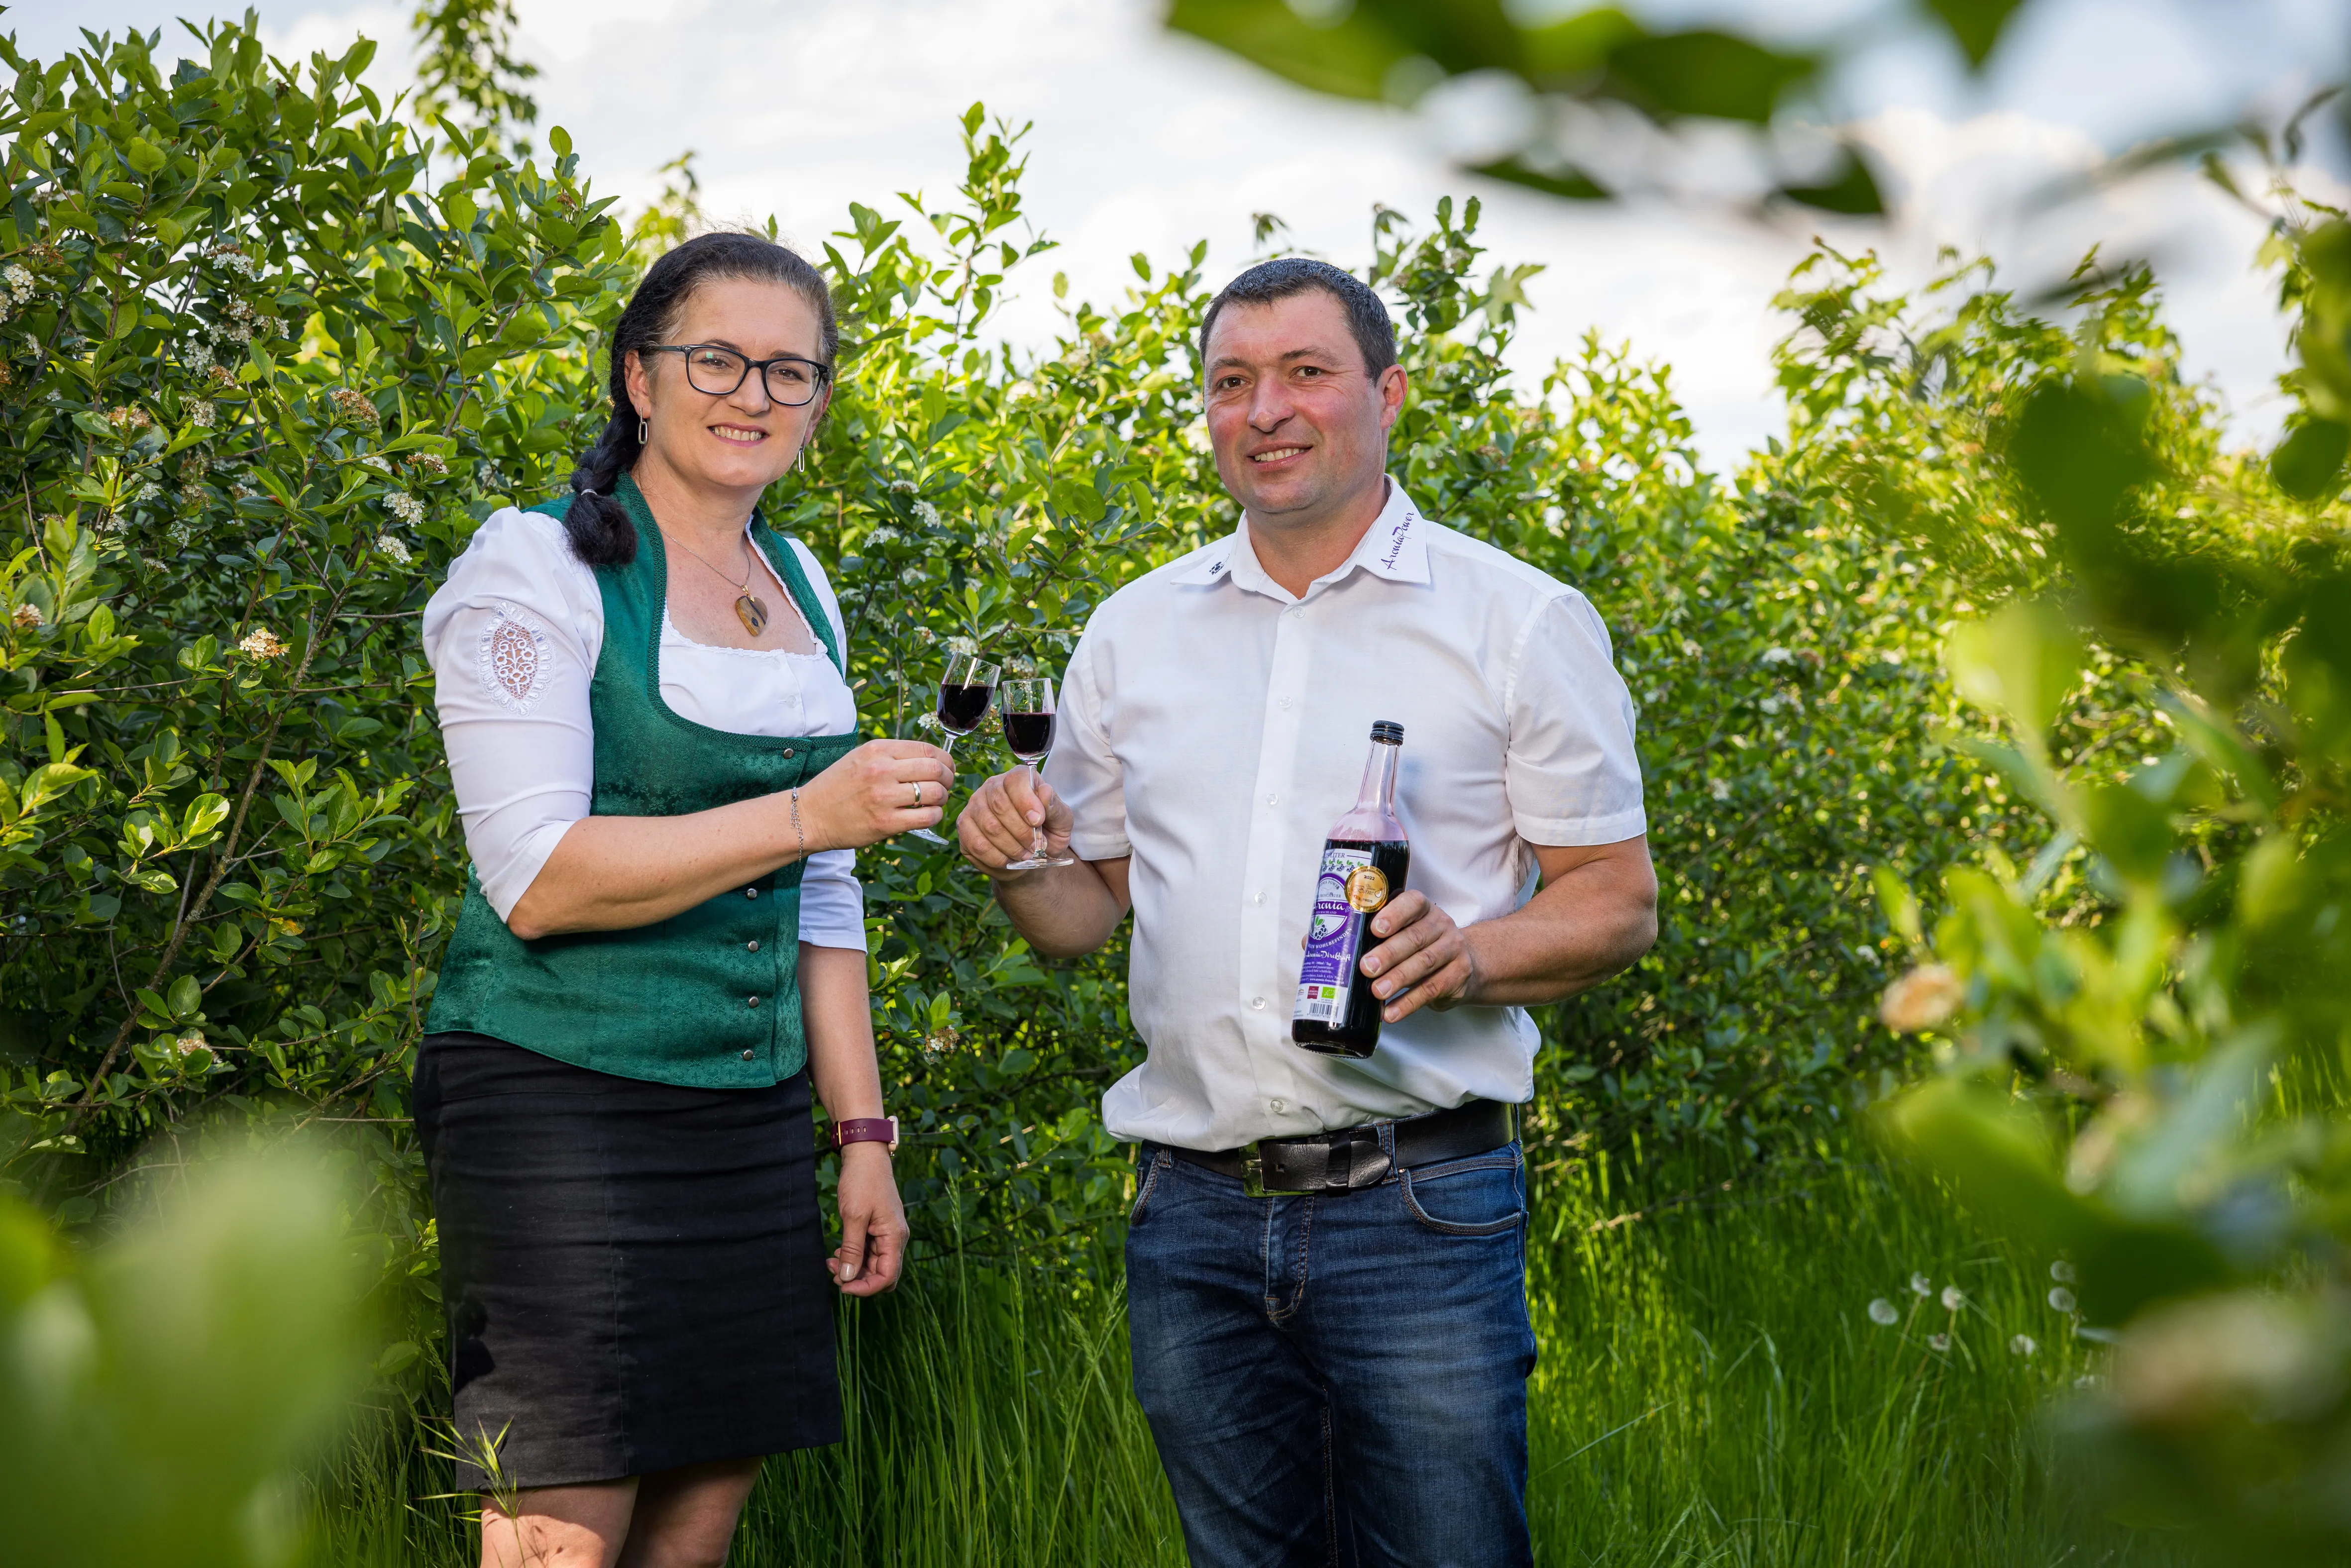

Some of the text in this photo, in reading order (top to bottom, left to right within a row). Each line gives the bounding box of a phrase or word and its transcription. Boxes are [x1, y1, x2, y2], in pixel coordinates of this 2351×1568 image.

[1381, 512, 1414, 571] AroniaPower
[1328, 880, 1340, 890] POWER
[1315, 927, 1352, 949] WOHLBEFINDEN
